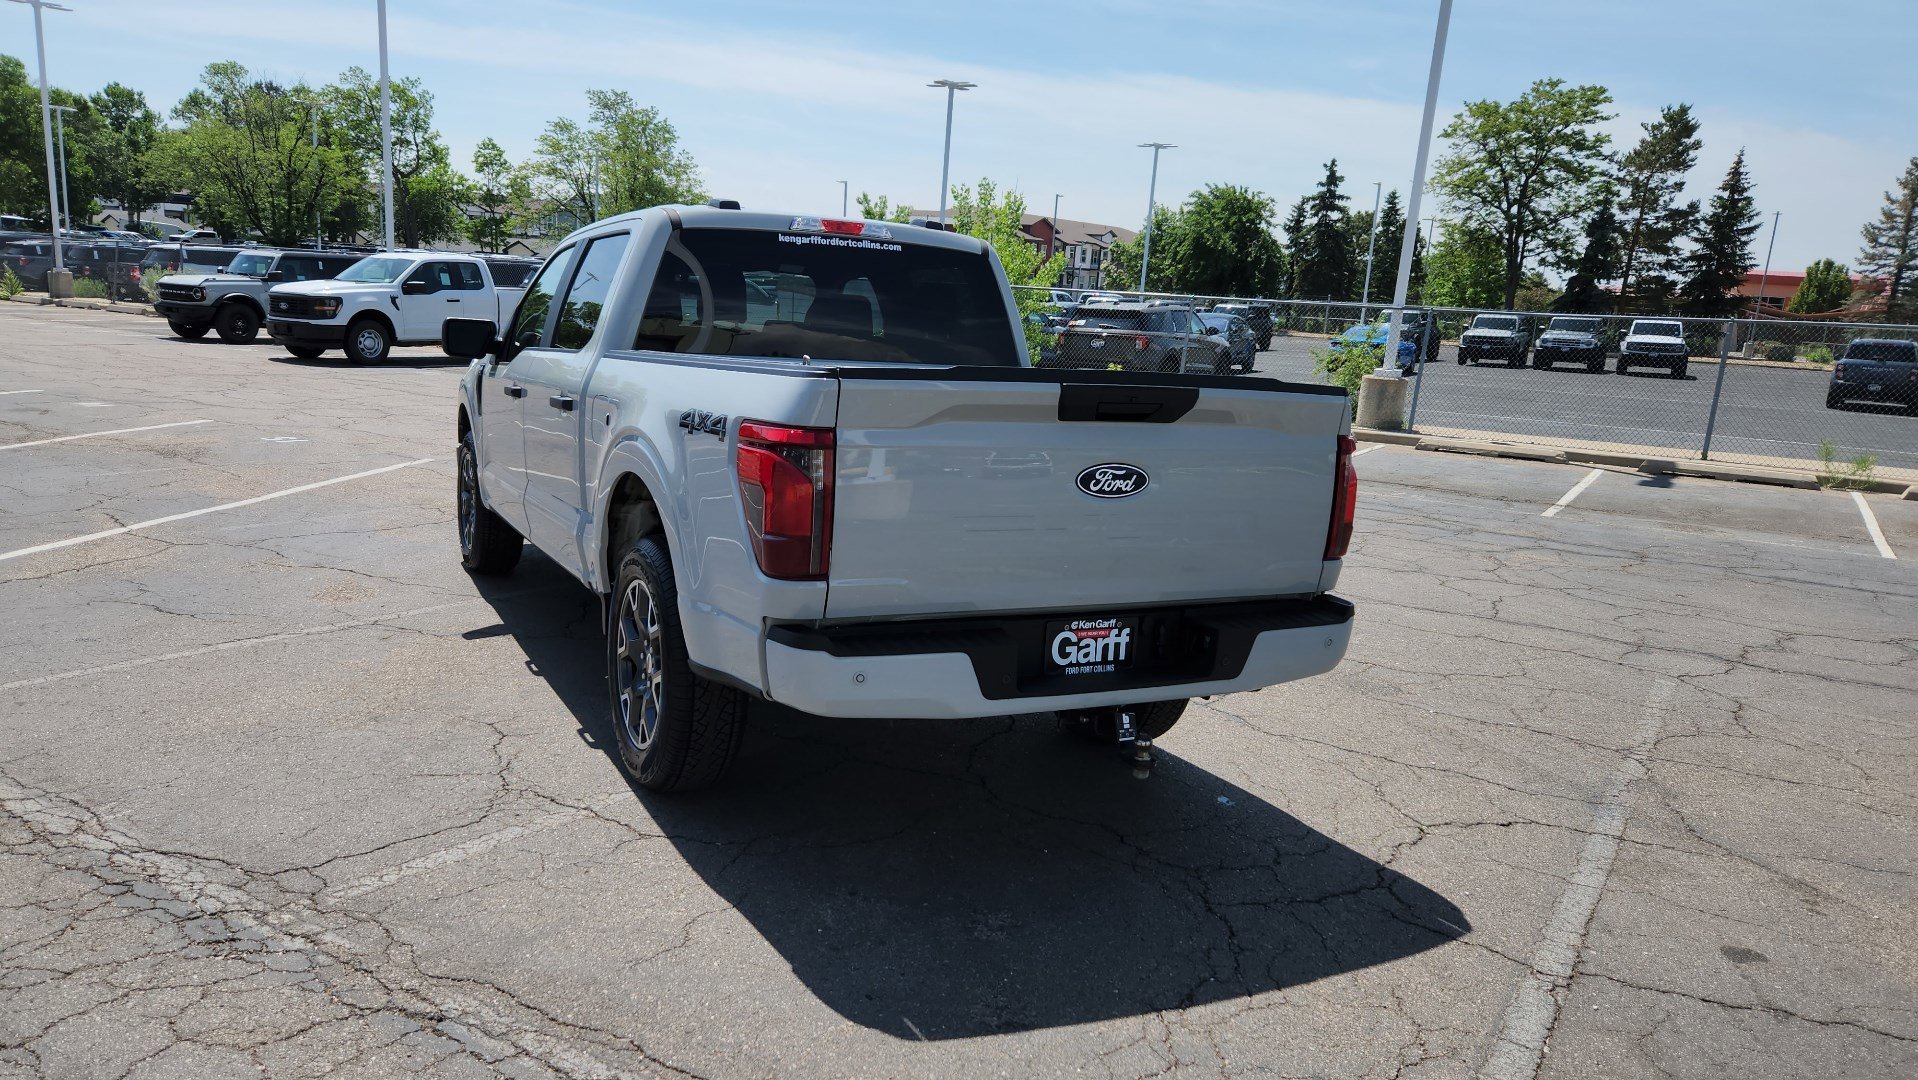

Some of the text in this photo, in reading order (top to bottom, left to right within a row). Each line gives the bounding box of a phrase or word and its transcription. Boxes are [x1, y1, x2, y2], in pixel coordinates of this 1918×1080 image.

[778, 233, 902, 252] kengarfffordfortcollins.com
[1089, 468, 1138, 492] Ford
[1079, 618, 1117, 629] Ken Garff
[1051, 627, 1131, 666] Garff
[1065, 664, 1115, 675] FORD FORT COLLINS
